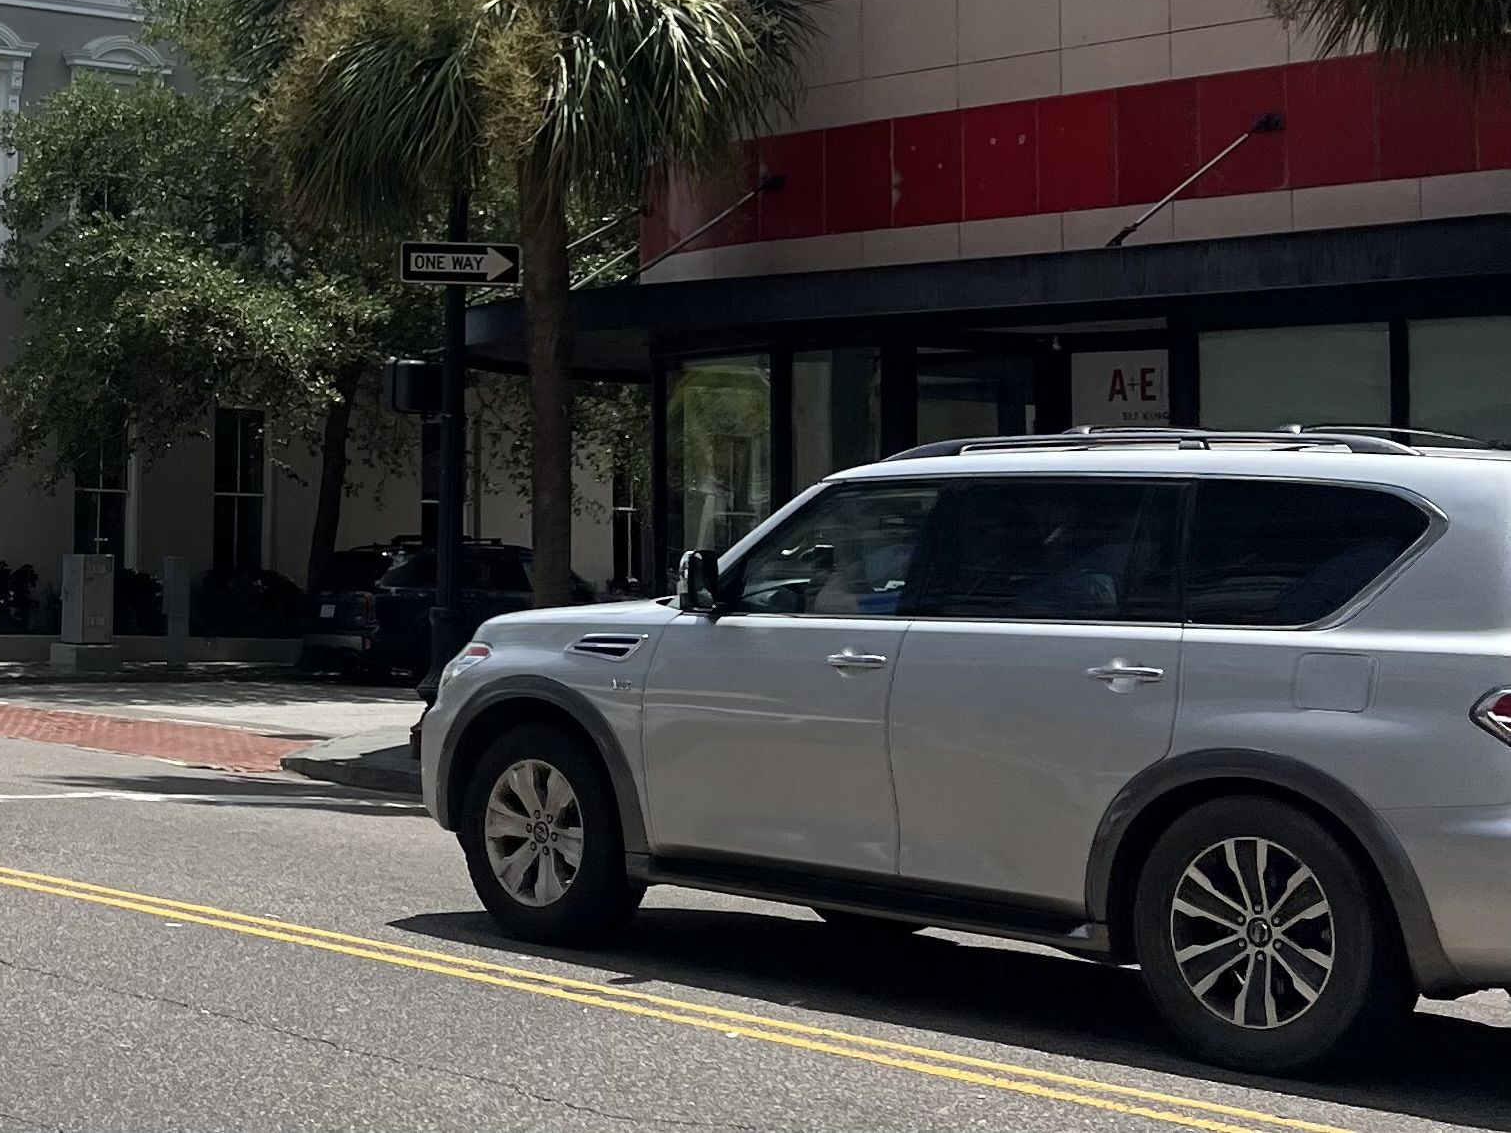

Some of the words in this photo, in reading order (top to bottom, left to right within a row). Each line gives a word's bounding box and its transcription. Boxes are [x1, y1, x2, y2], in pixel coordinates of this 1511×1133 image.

[414, 254, 446, 270] ONE
[451, 255, 484, 271] WAY
[1108, 367, 1157, 402] A+E
